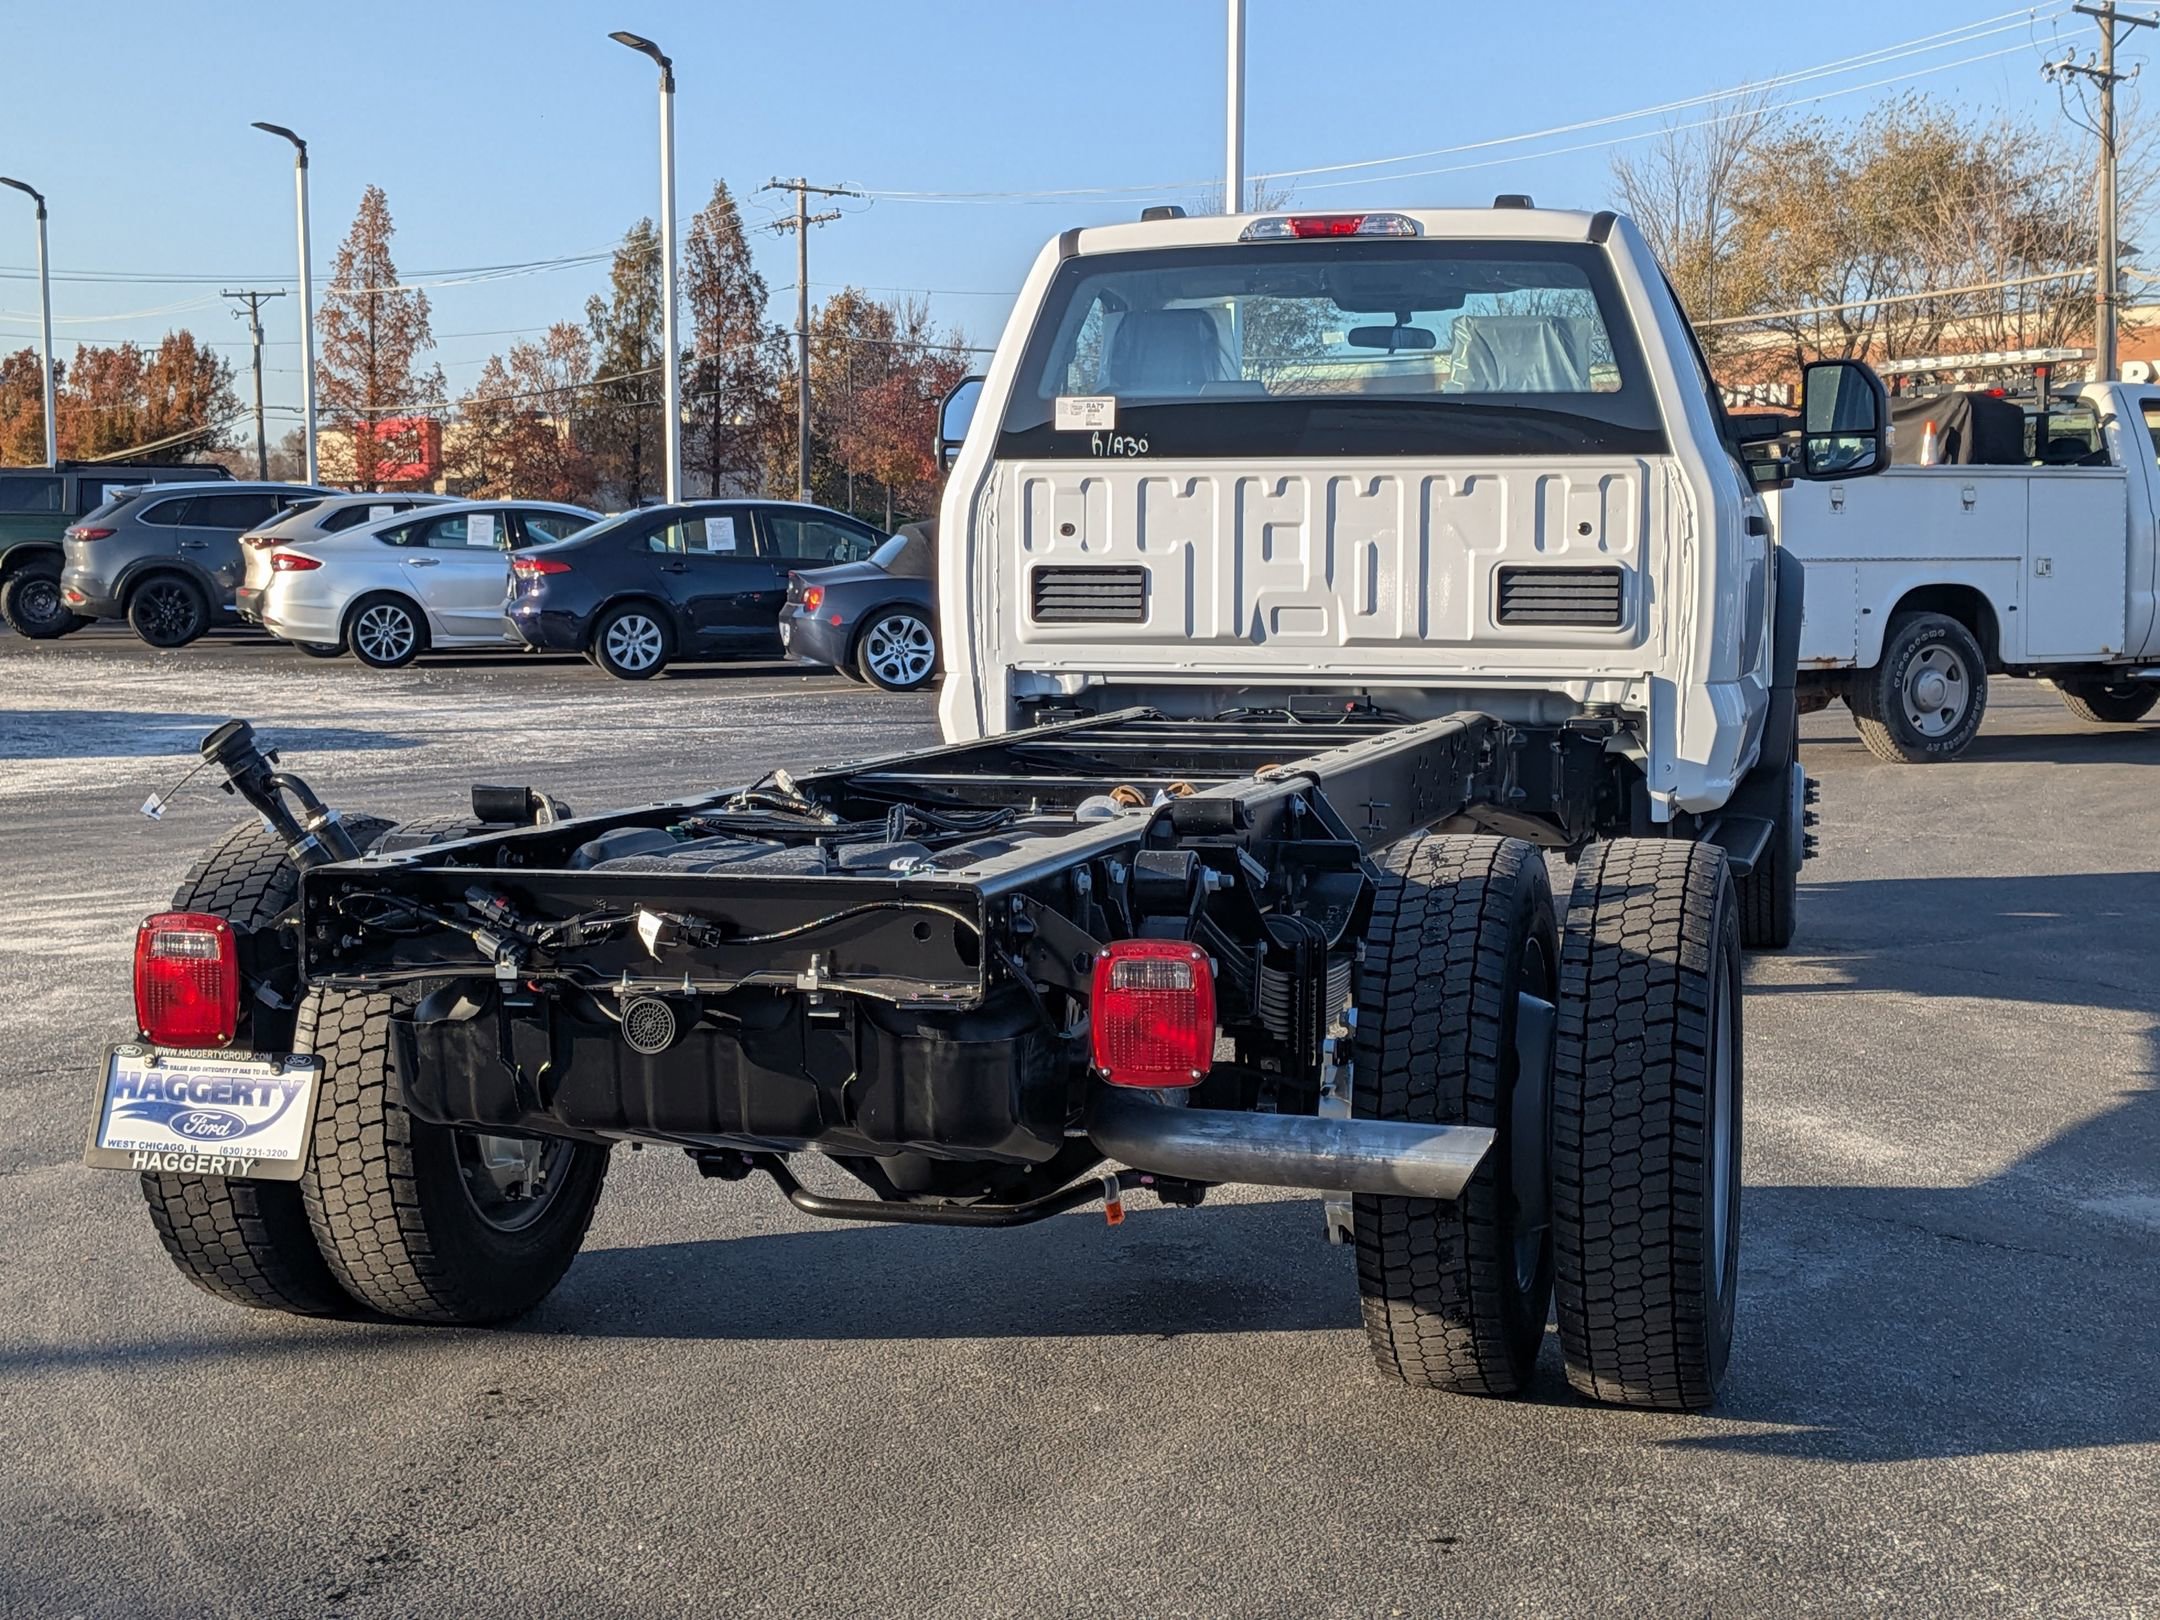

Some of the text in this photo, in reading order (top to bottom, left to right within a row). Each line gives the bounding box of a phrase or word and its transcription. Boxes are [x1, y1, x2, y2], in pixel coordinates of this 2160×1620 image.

[154, 1046, 273, 1061] WWW.HAGGERTYGROUP.COM
[115, 1070, 305, 1107] HAGGERTY
[183, 1112, 231, 1137] Ford
[107, 1139, 199, 1153] WEST CHICAGO, IL
[219, 1145, 289, 1158] (630) 231-3200
[132, 1151, 255, 1176] HAGGERTY
